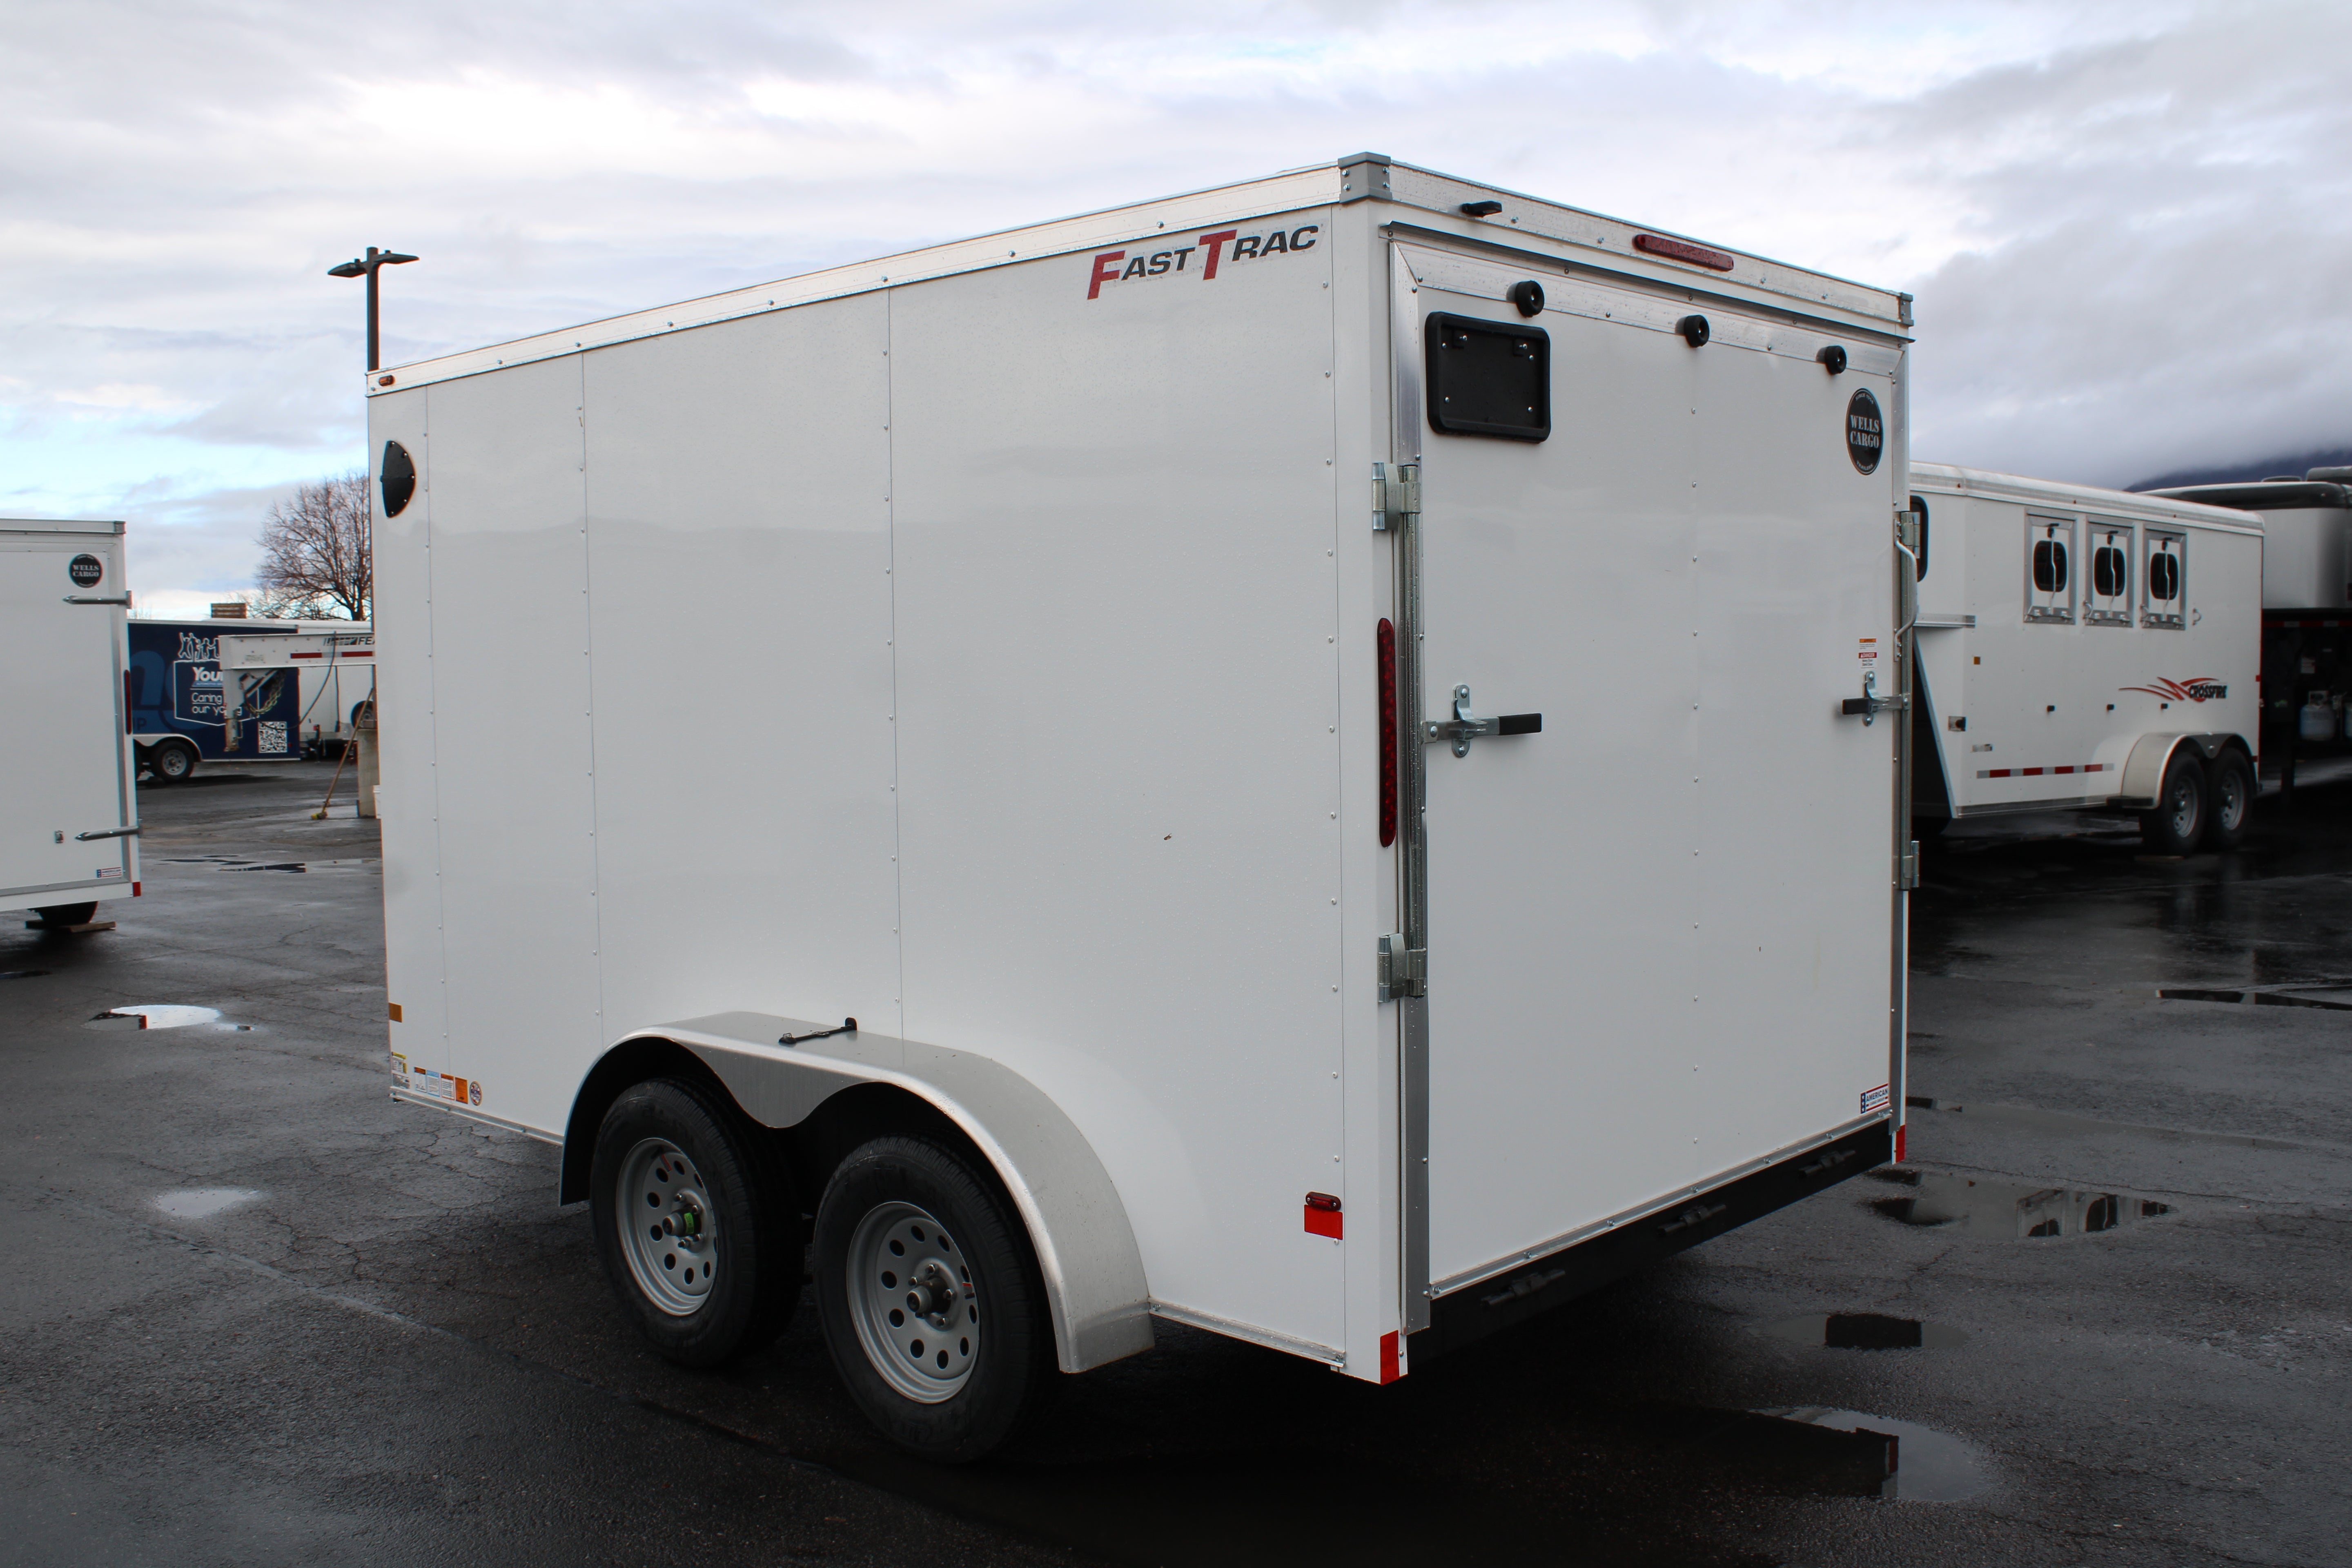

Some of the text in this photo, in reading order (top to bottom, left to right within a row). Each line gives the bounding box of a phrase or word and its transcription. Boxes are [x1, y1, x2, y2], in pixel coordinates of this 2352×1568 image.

[1087, 225, 1319, 300] FAST TRAC
[1850, 414, 1879, 433] WELLS
[1850, 432, 1879, 449] CARGO
[192, 693, 223, 705] Caring
[2189, 685, 2227, 699] CROSSFIRE
